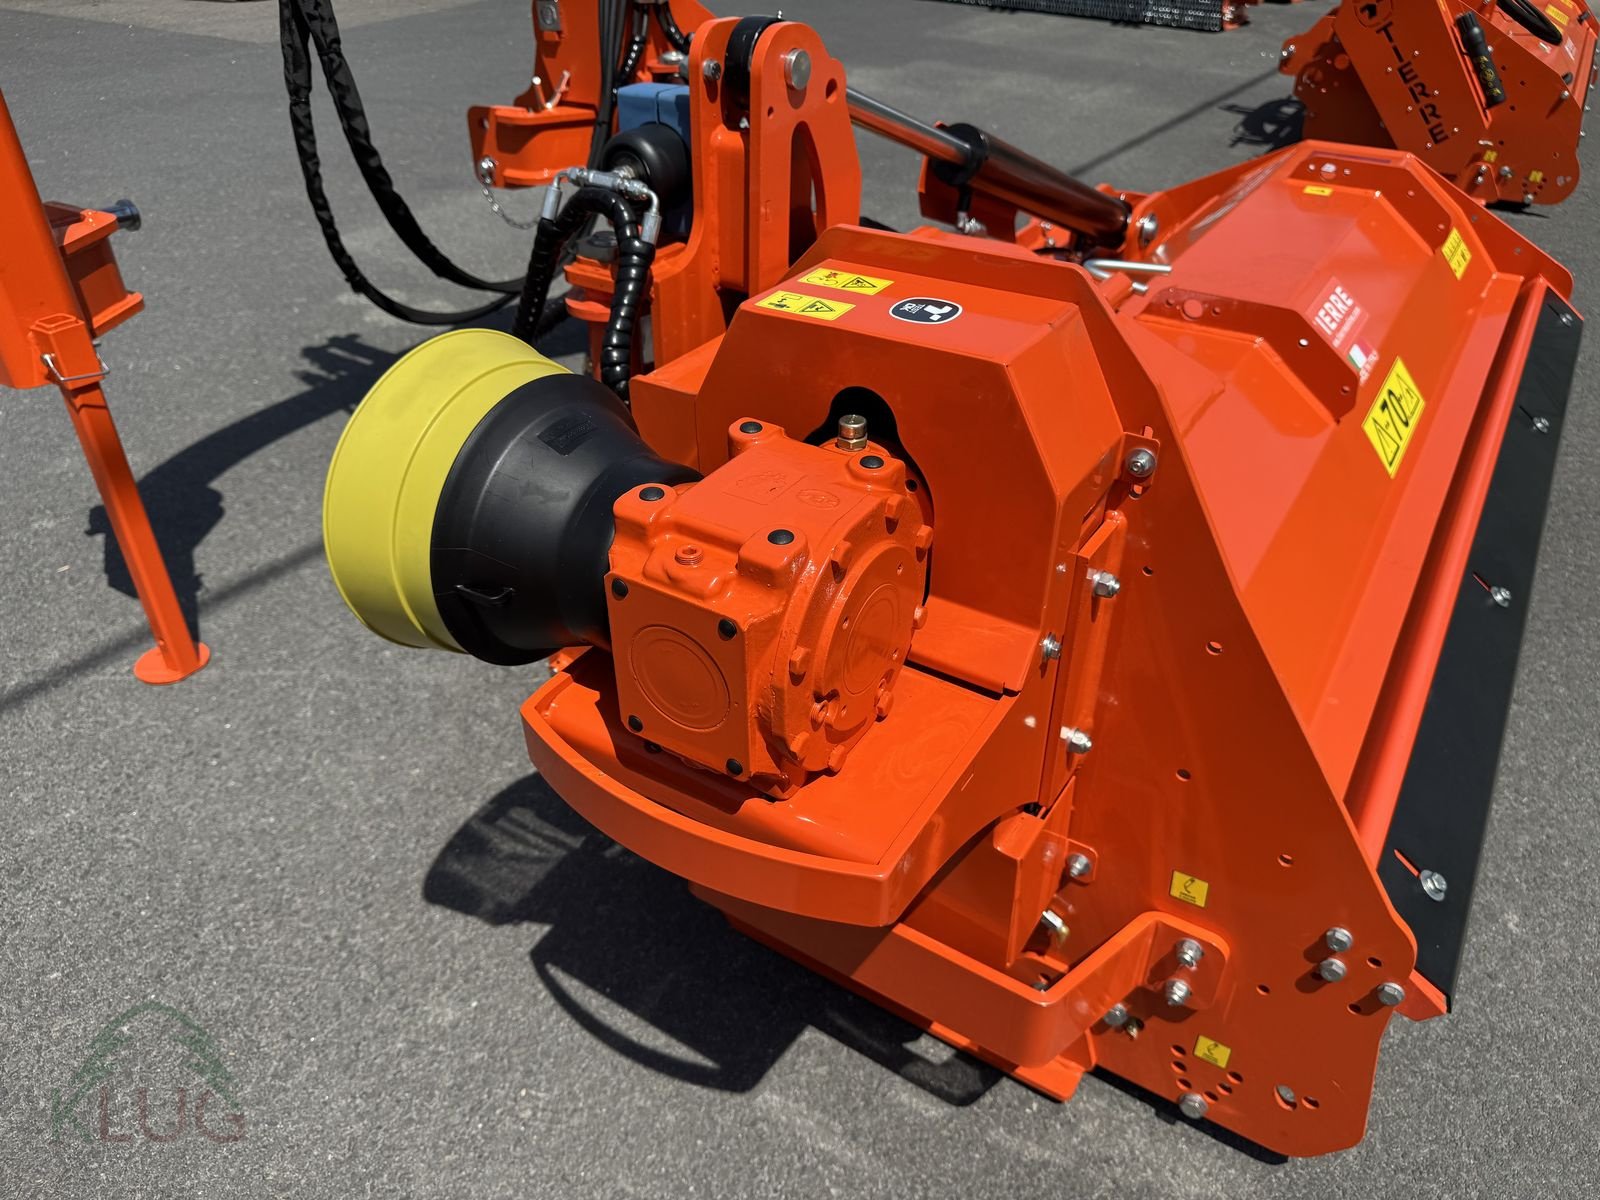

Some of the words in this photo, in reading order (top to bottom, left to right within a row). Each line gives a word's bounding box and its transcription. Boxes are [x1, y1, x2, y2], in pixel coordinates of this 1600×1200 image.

[1375, 21, 1449, 145] TIERRE
[1312, 286, 1354, 335] IERRE
[1380, 389, 1409, 441] 70
